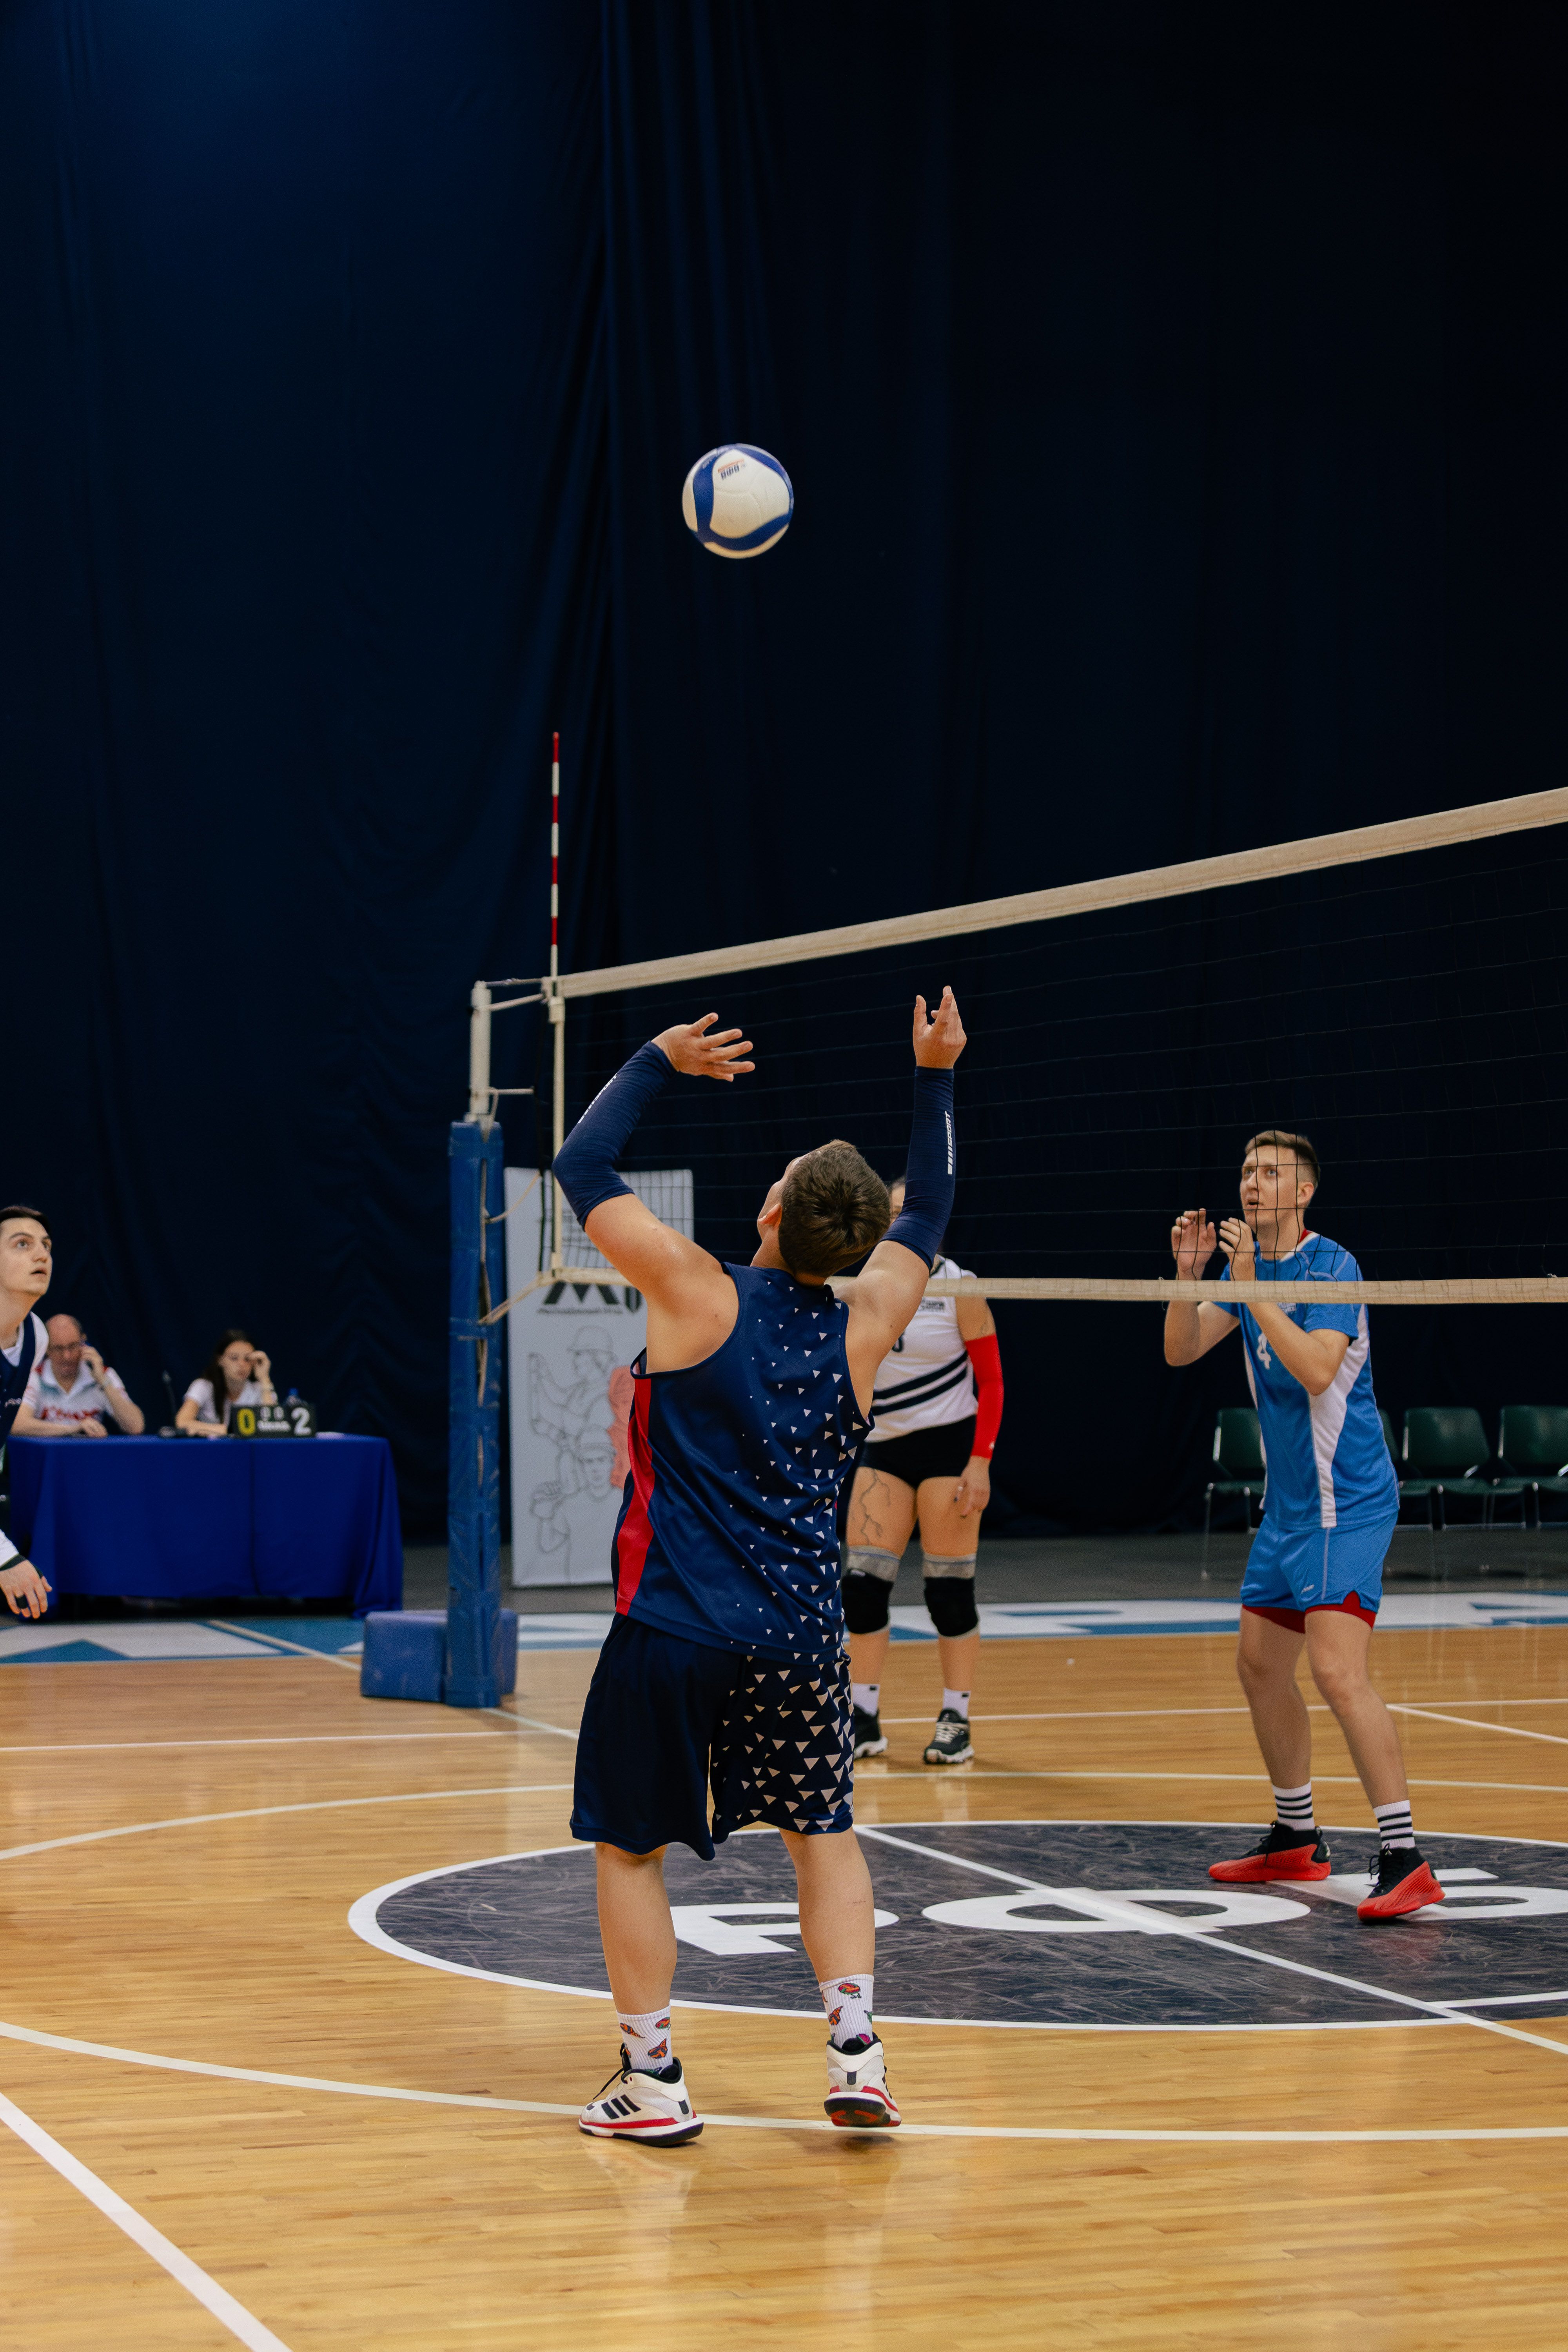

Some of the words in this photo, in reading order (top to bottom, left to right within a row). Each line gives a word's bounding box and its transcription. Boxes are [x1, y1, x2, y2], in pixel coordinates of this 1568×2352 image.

[1257, 1333, 1271, 1369] 4
[237, 1408, 255, 1436] 0
[291, 1407, 311, 1436] 2
